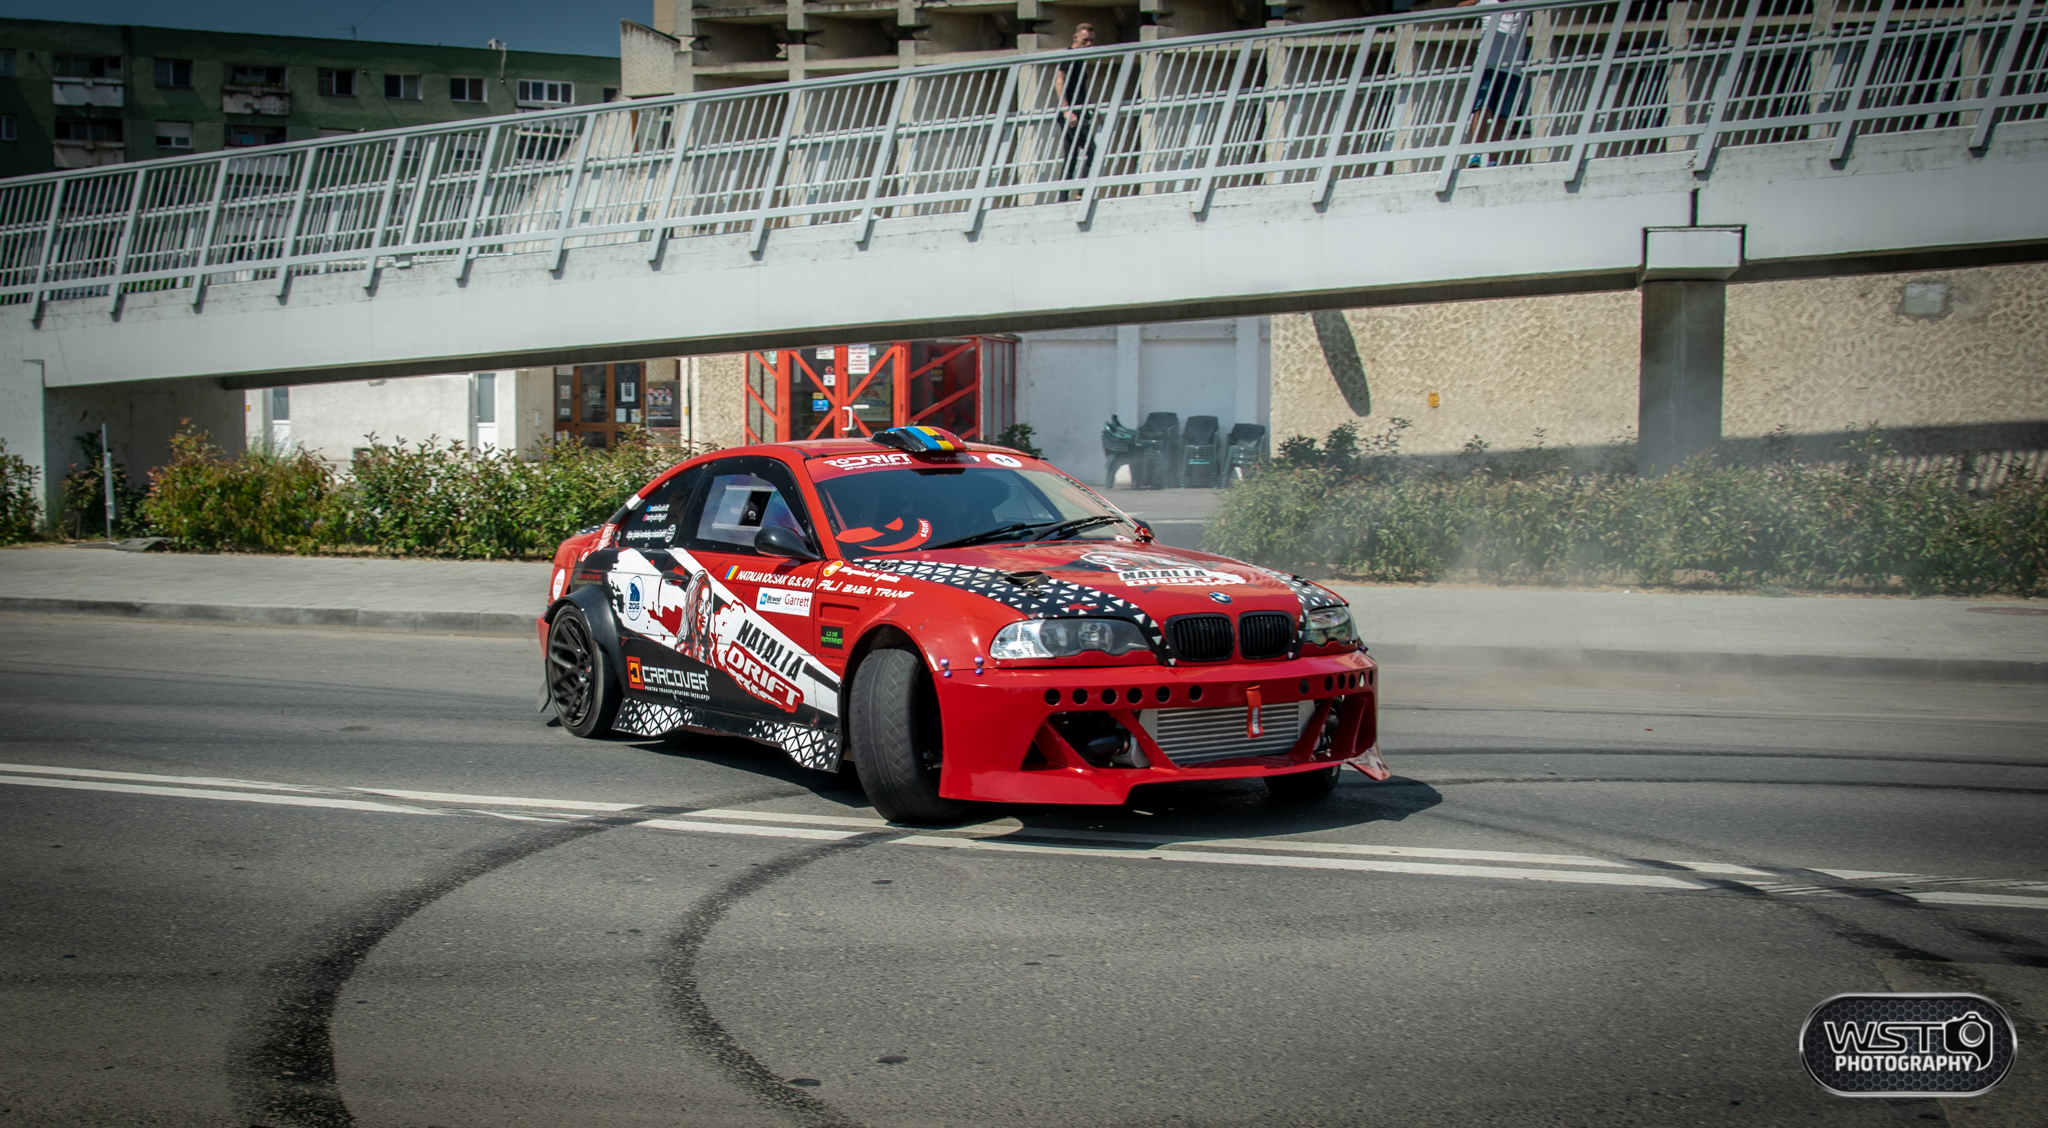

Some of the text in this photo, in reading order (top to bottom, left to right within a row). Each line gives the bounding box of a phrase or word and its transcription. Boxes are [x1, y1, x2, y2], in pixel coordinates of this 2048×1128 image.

[736, 570, 764, 582] NATALIA
[1122, 569, 1207, 579] NATALIA
[816, 579, 915, 598] ALI BABA TRANS
[767, 594, 782, 602] Brand
[784, 593, 810, 608] Garrett
[736, 619, 805, 681] NATALIA
[727, 646, 802, 707] DRIFT
